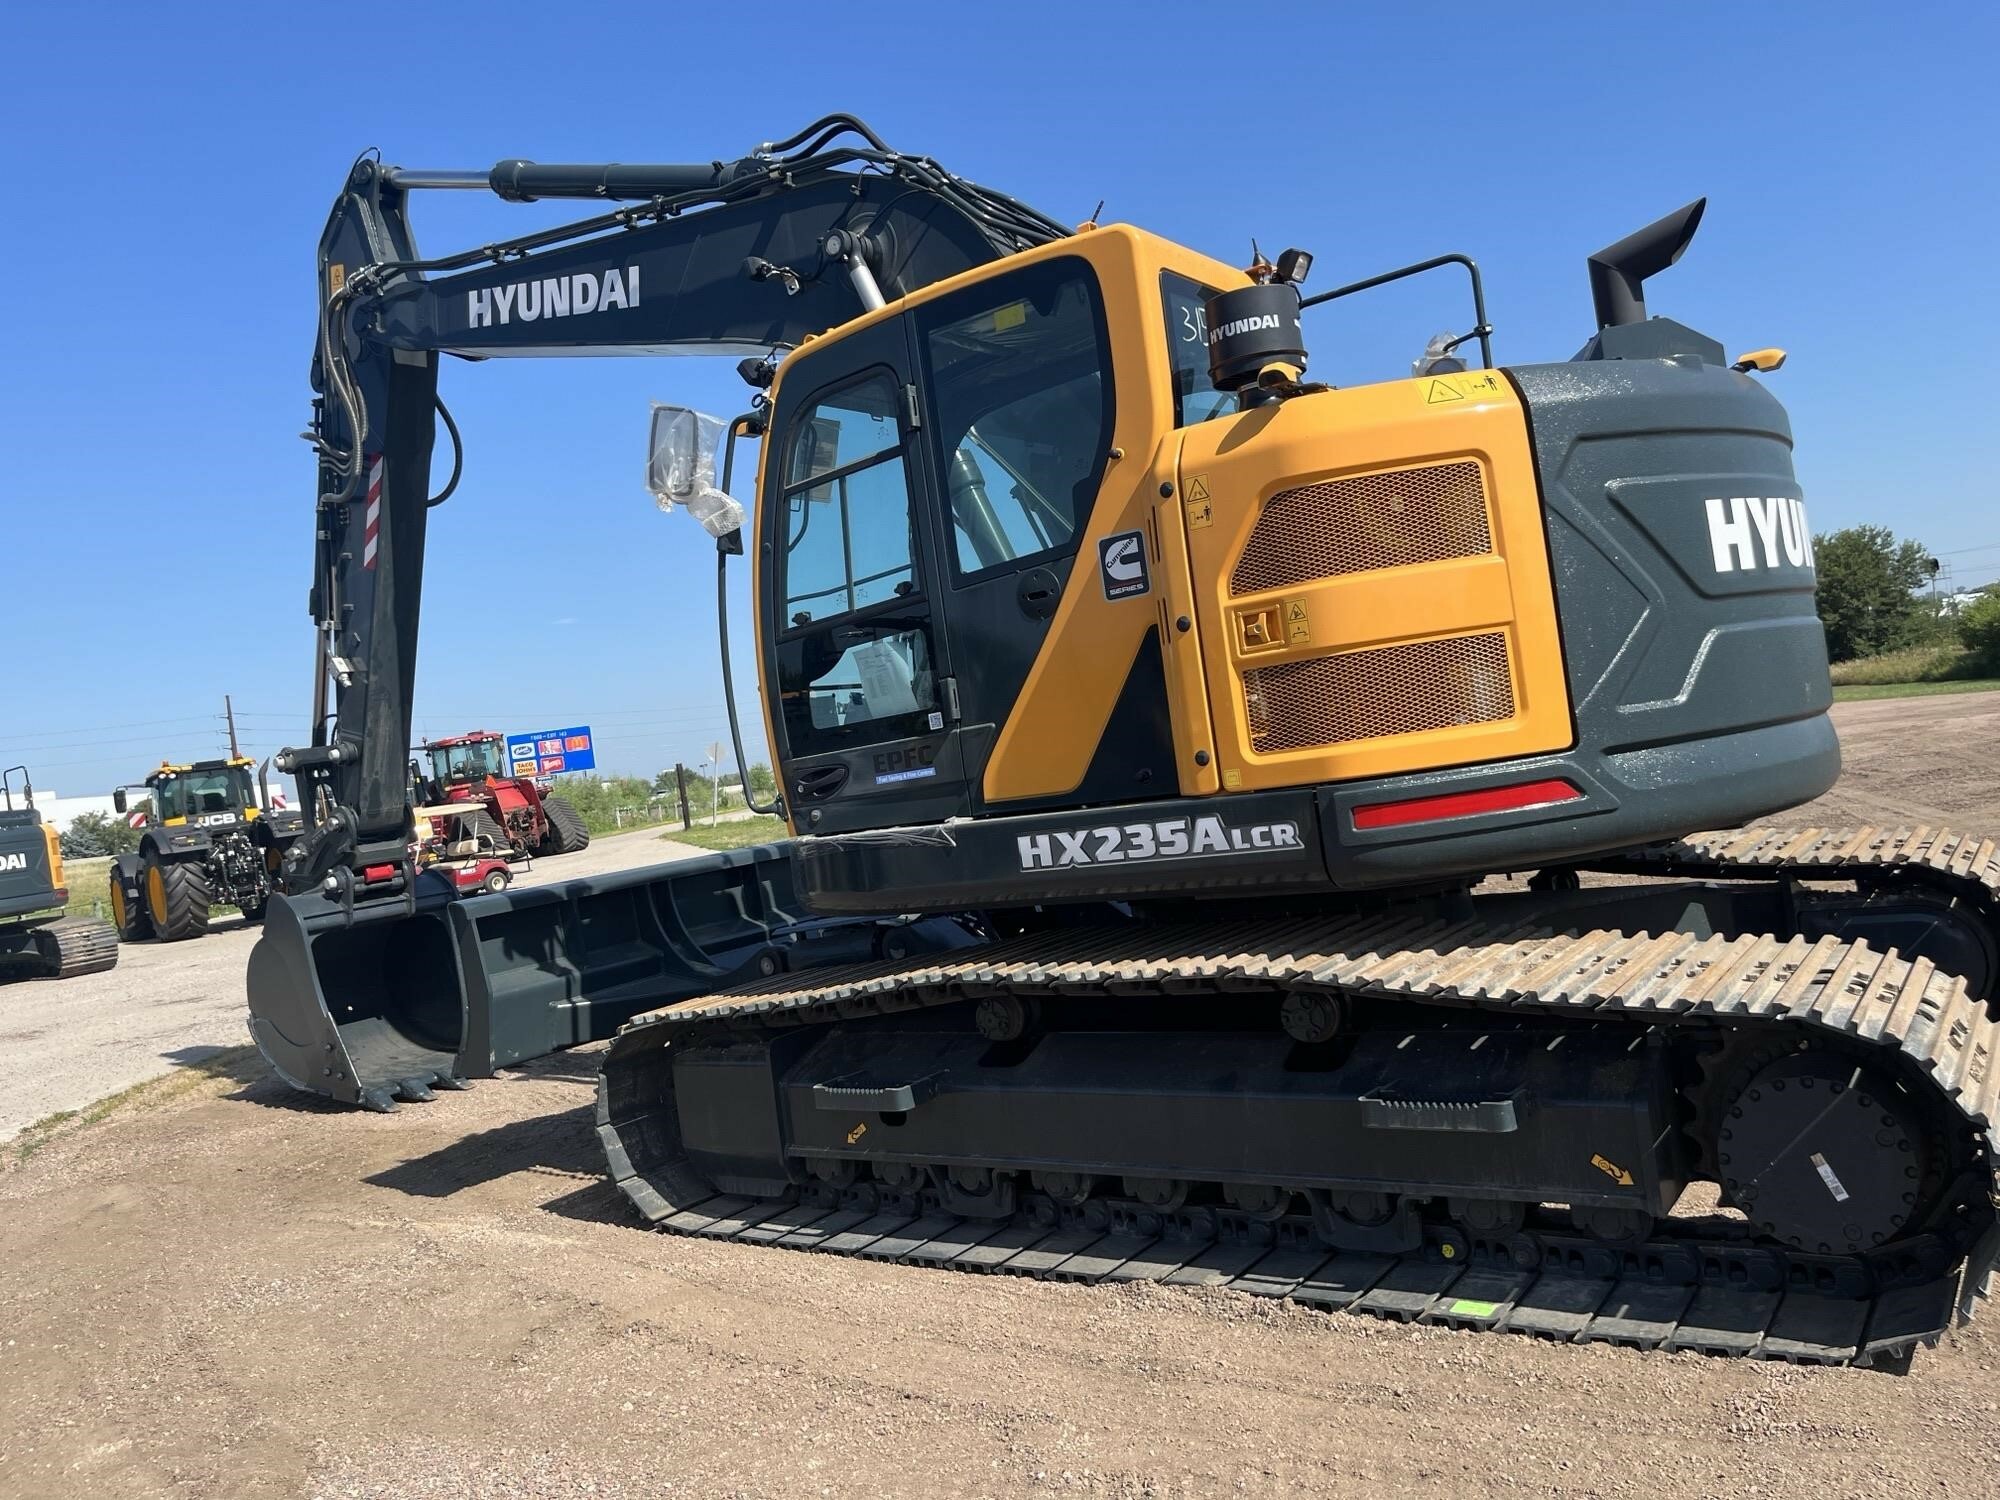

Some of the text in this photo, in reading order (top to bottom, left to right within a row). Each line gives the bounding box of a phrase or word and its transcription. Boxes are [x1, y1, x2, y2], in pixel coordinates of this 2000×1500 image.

[469, 266, 640, 328] HYUNDAI
[1210, 314, 1280, 345] HYUNDAI
[1106, 538, 1135, 569] Cummins
[1109, 583, 1144, 595] SERIES
[873, 745, 934, 773] EPFC
[200, 813, 236, 827] JCB
